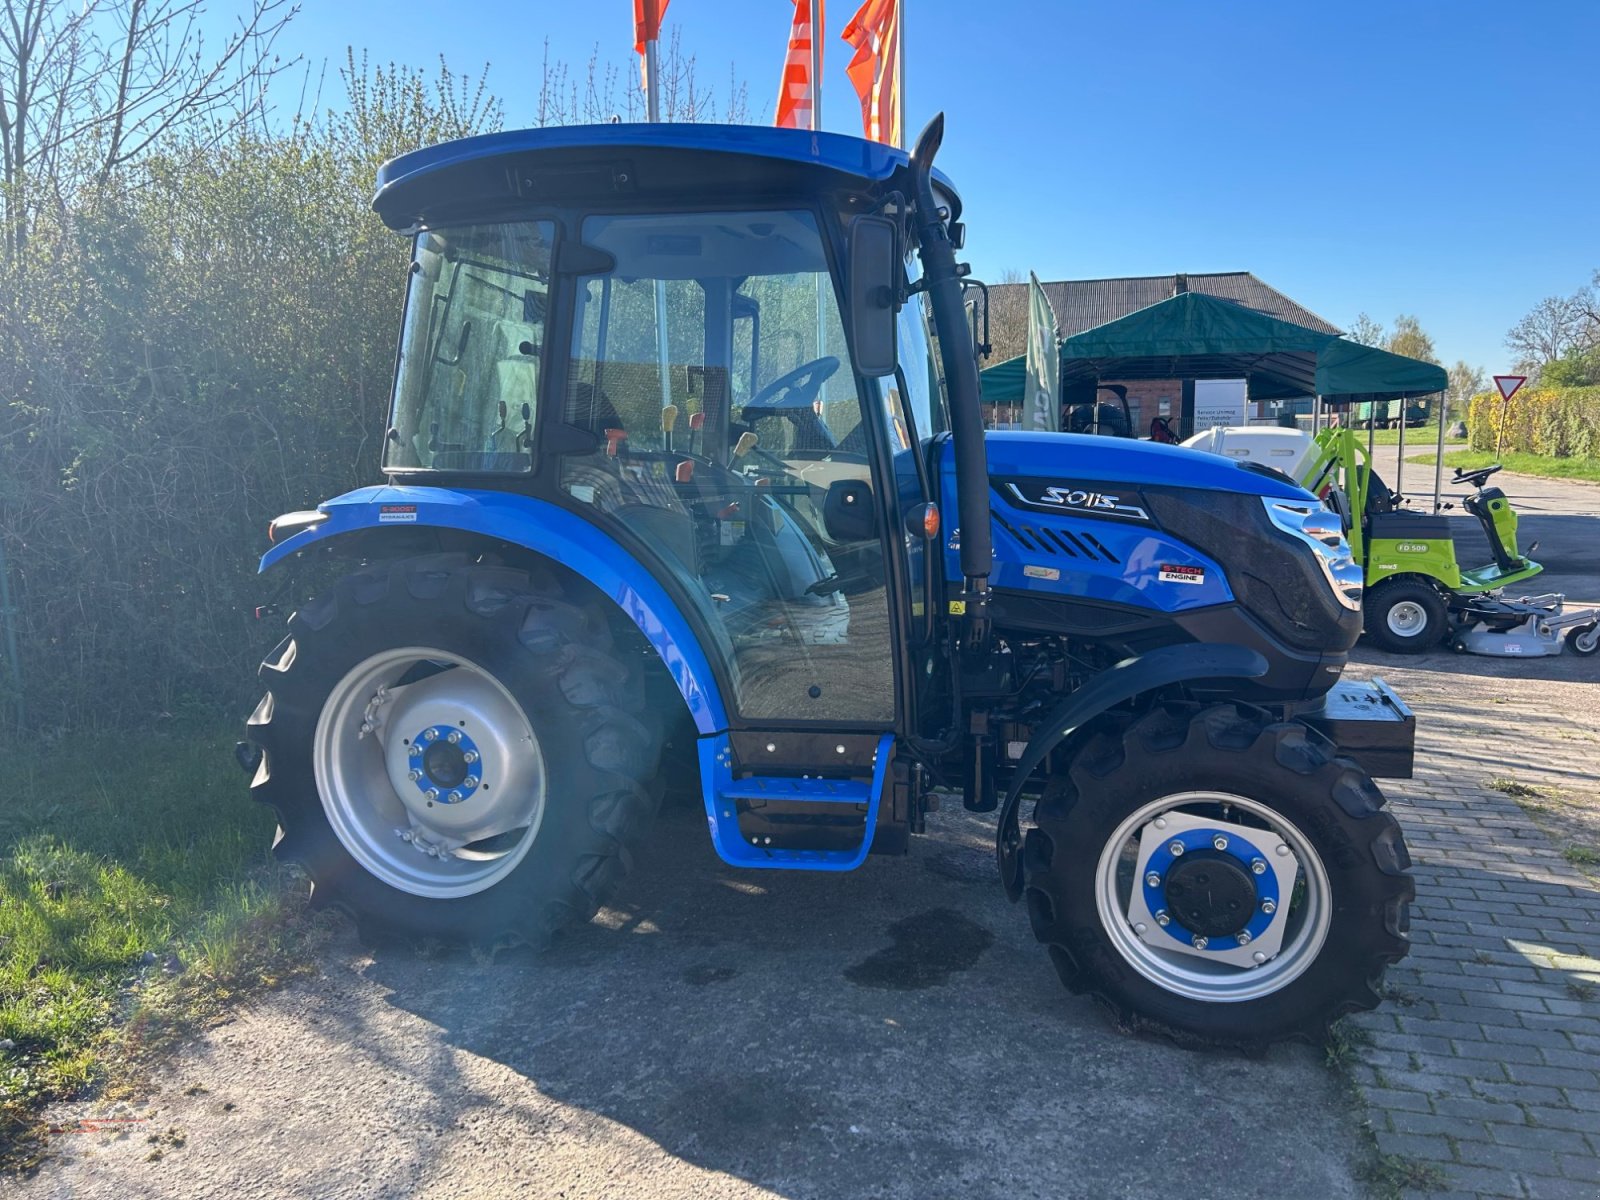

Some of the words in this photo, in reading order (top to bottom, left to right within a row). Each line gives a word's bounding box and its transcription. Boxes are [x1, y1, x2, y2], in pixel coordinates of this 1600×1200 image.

[1040, 486, 1120, 509] SOLIS
[1163, 565, 1201, 575] S-TECH
[1165, 573, 1198, 581] ENGINE
